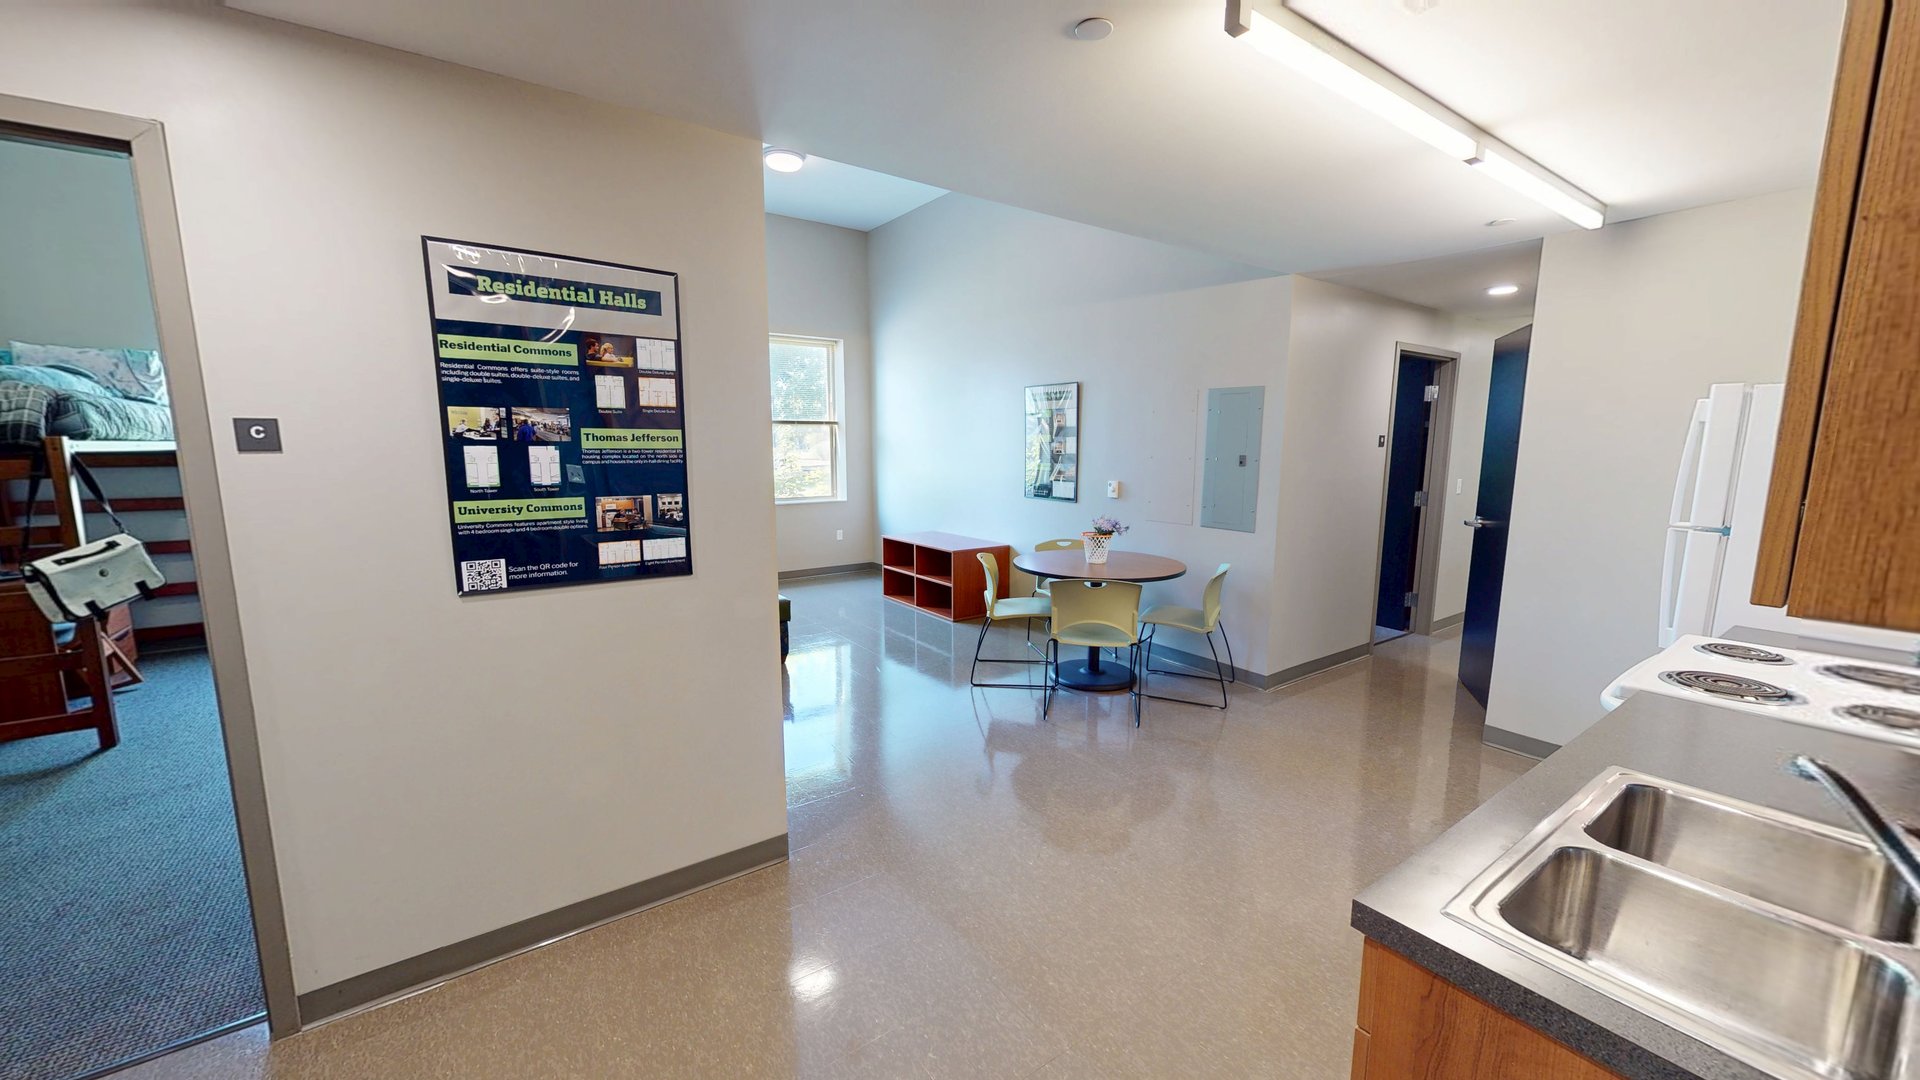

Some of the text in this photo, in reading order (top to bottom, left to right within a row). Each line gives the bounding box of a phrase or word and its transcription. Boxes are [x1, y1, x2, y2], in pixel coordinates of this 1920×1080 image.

[476, 275, 647, 310] Residential Halls
[439, 339, 572, 357] Residential Commons
[441, 369, 469, 377] including
[249, 425, 266, 439] C
[583, 433, 679, 442] Thomas Jefferson
[457, 503, 583, 516] University Commons
[528, 570, 568, 578] information.
